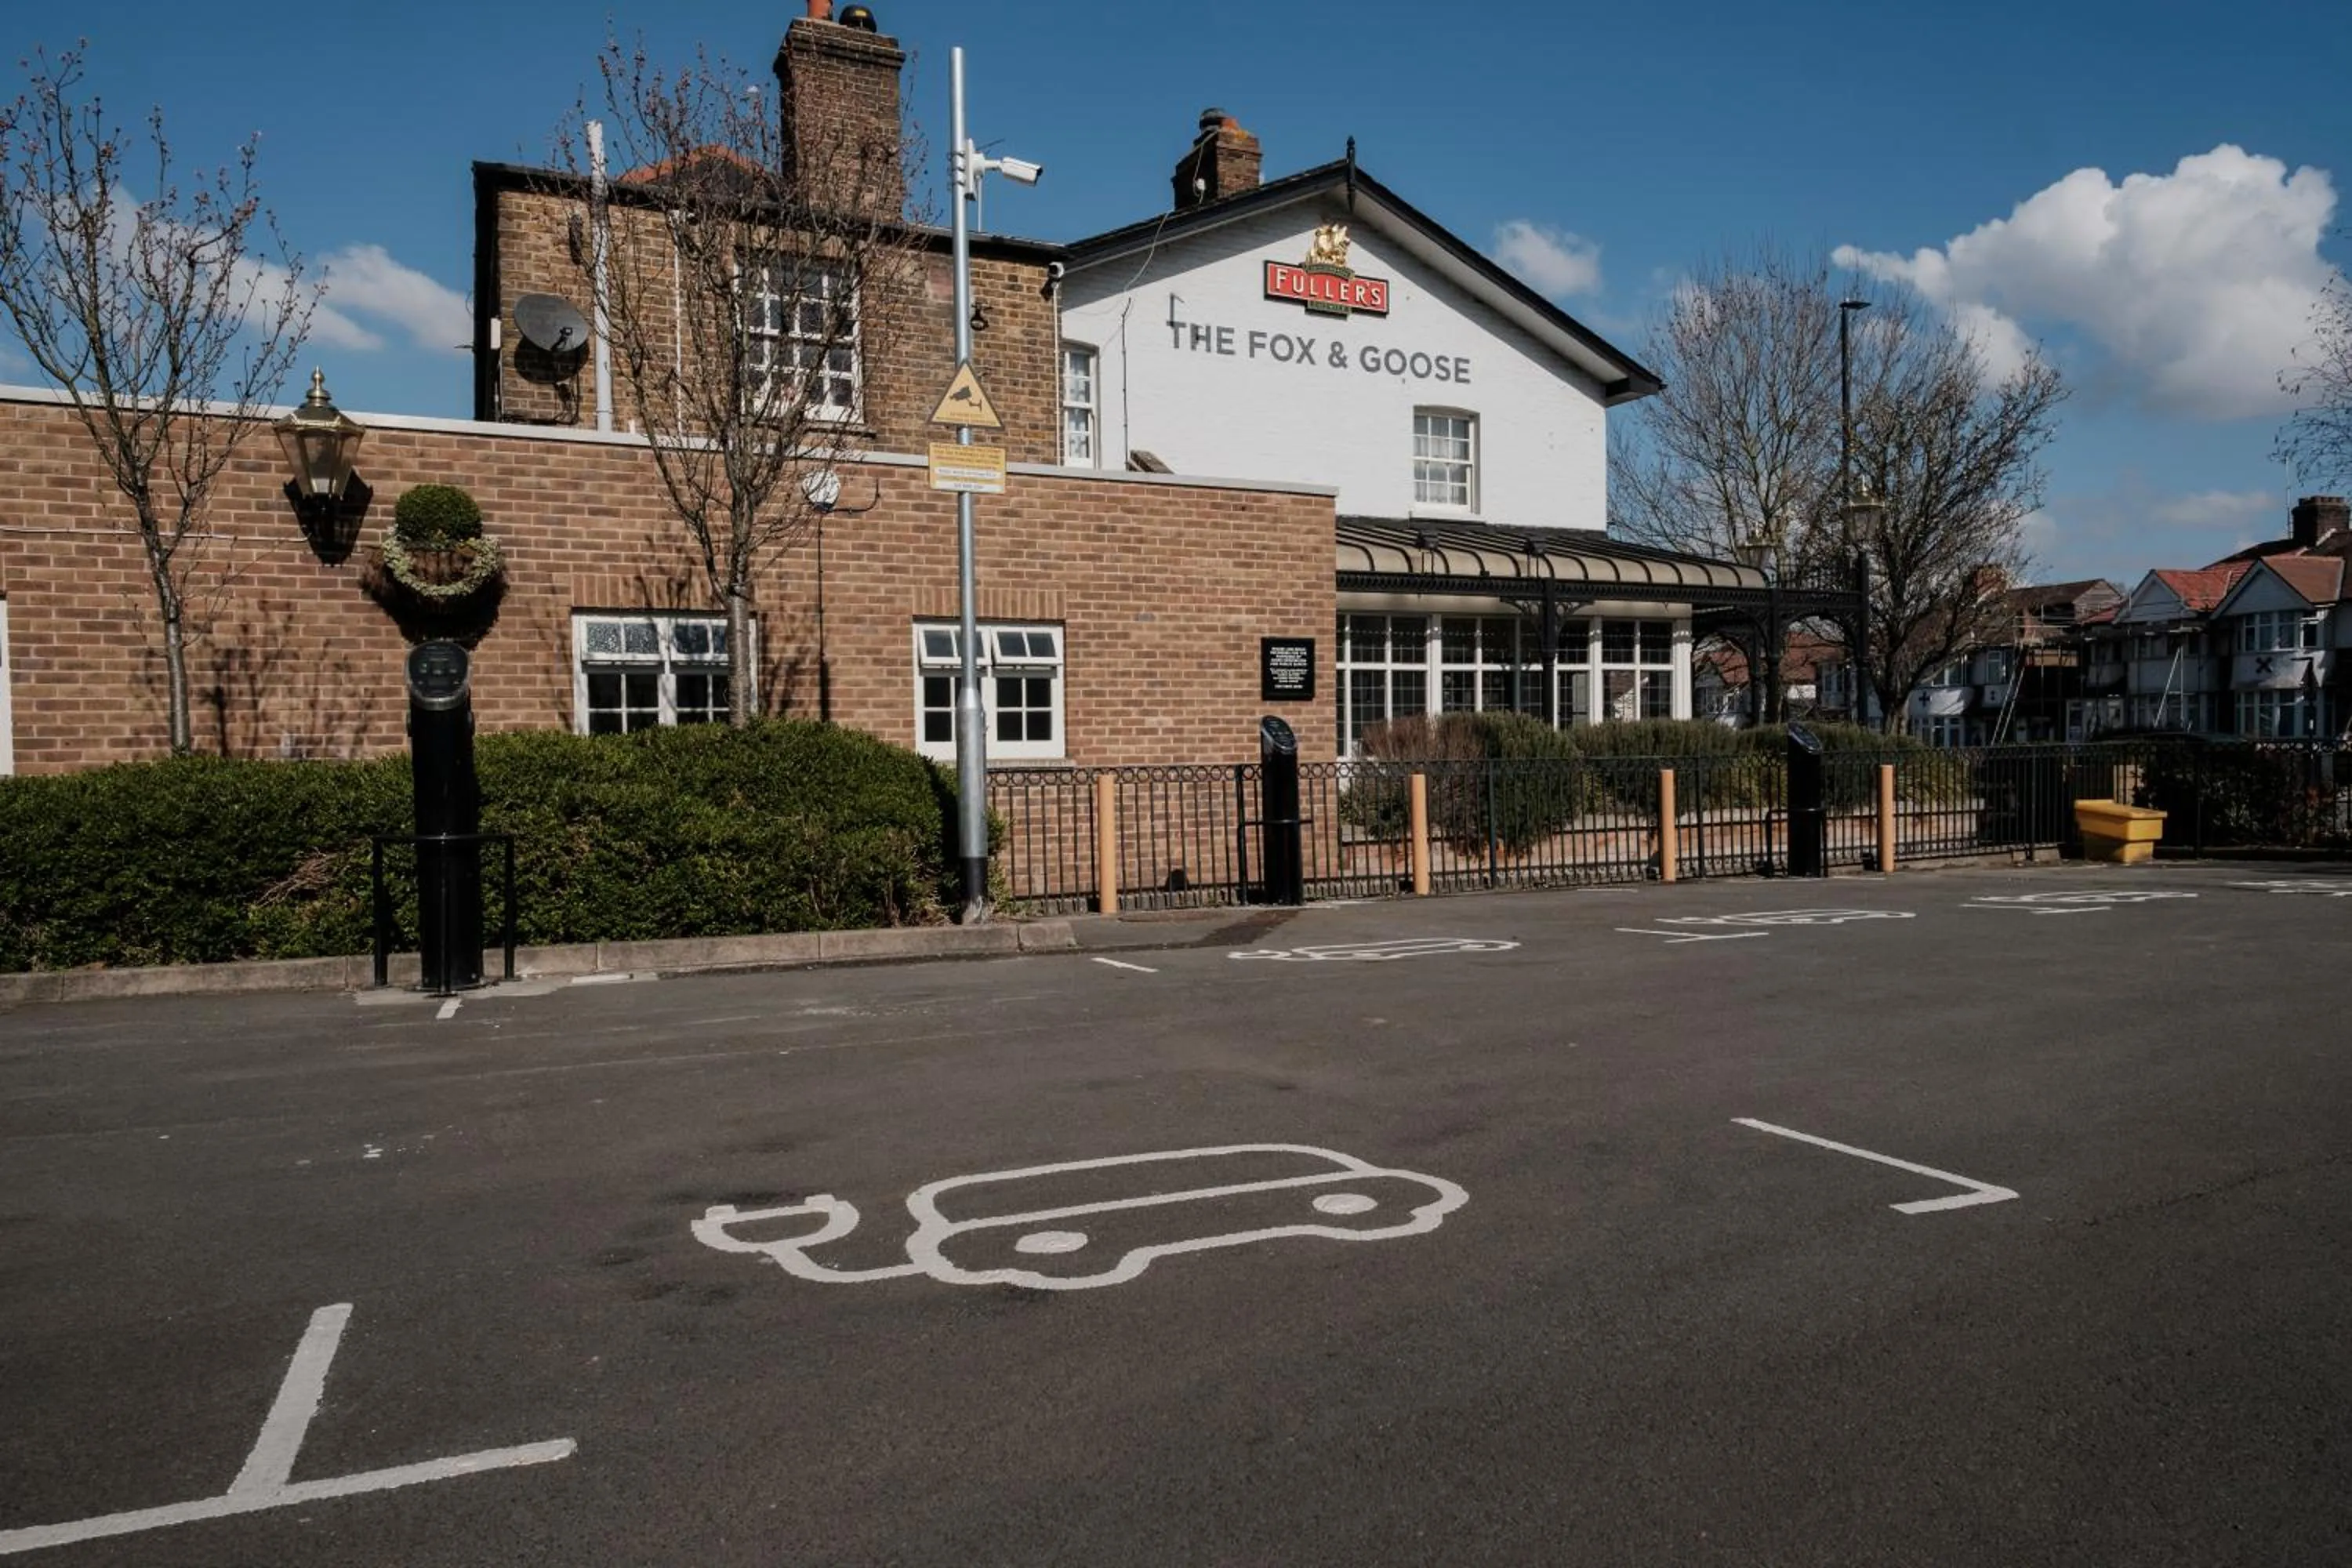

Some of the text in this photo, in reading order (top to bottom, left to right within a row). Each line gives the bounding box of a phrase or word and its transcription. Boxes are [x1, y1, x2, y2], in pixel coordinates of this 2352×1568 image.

[1167, 321, 1471, 383] THE FOX & GOOSE
